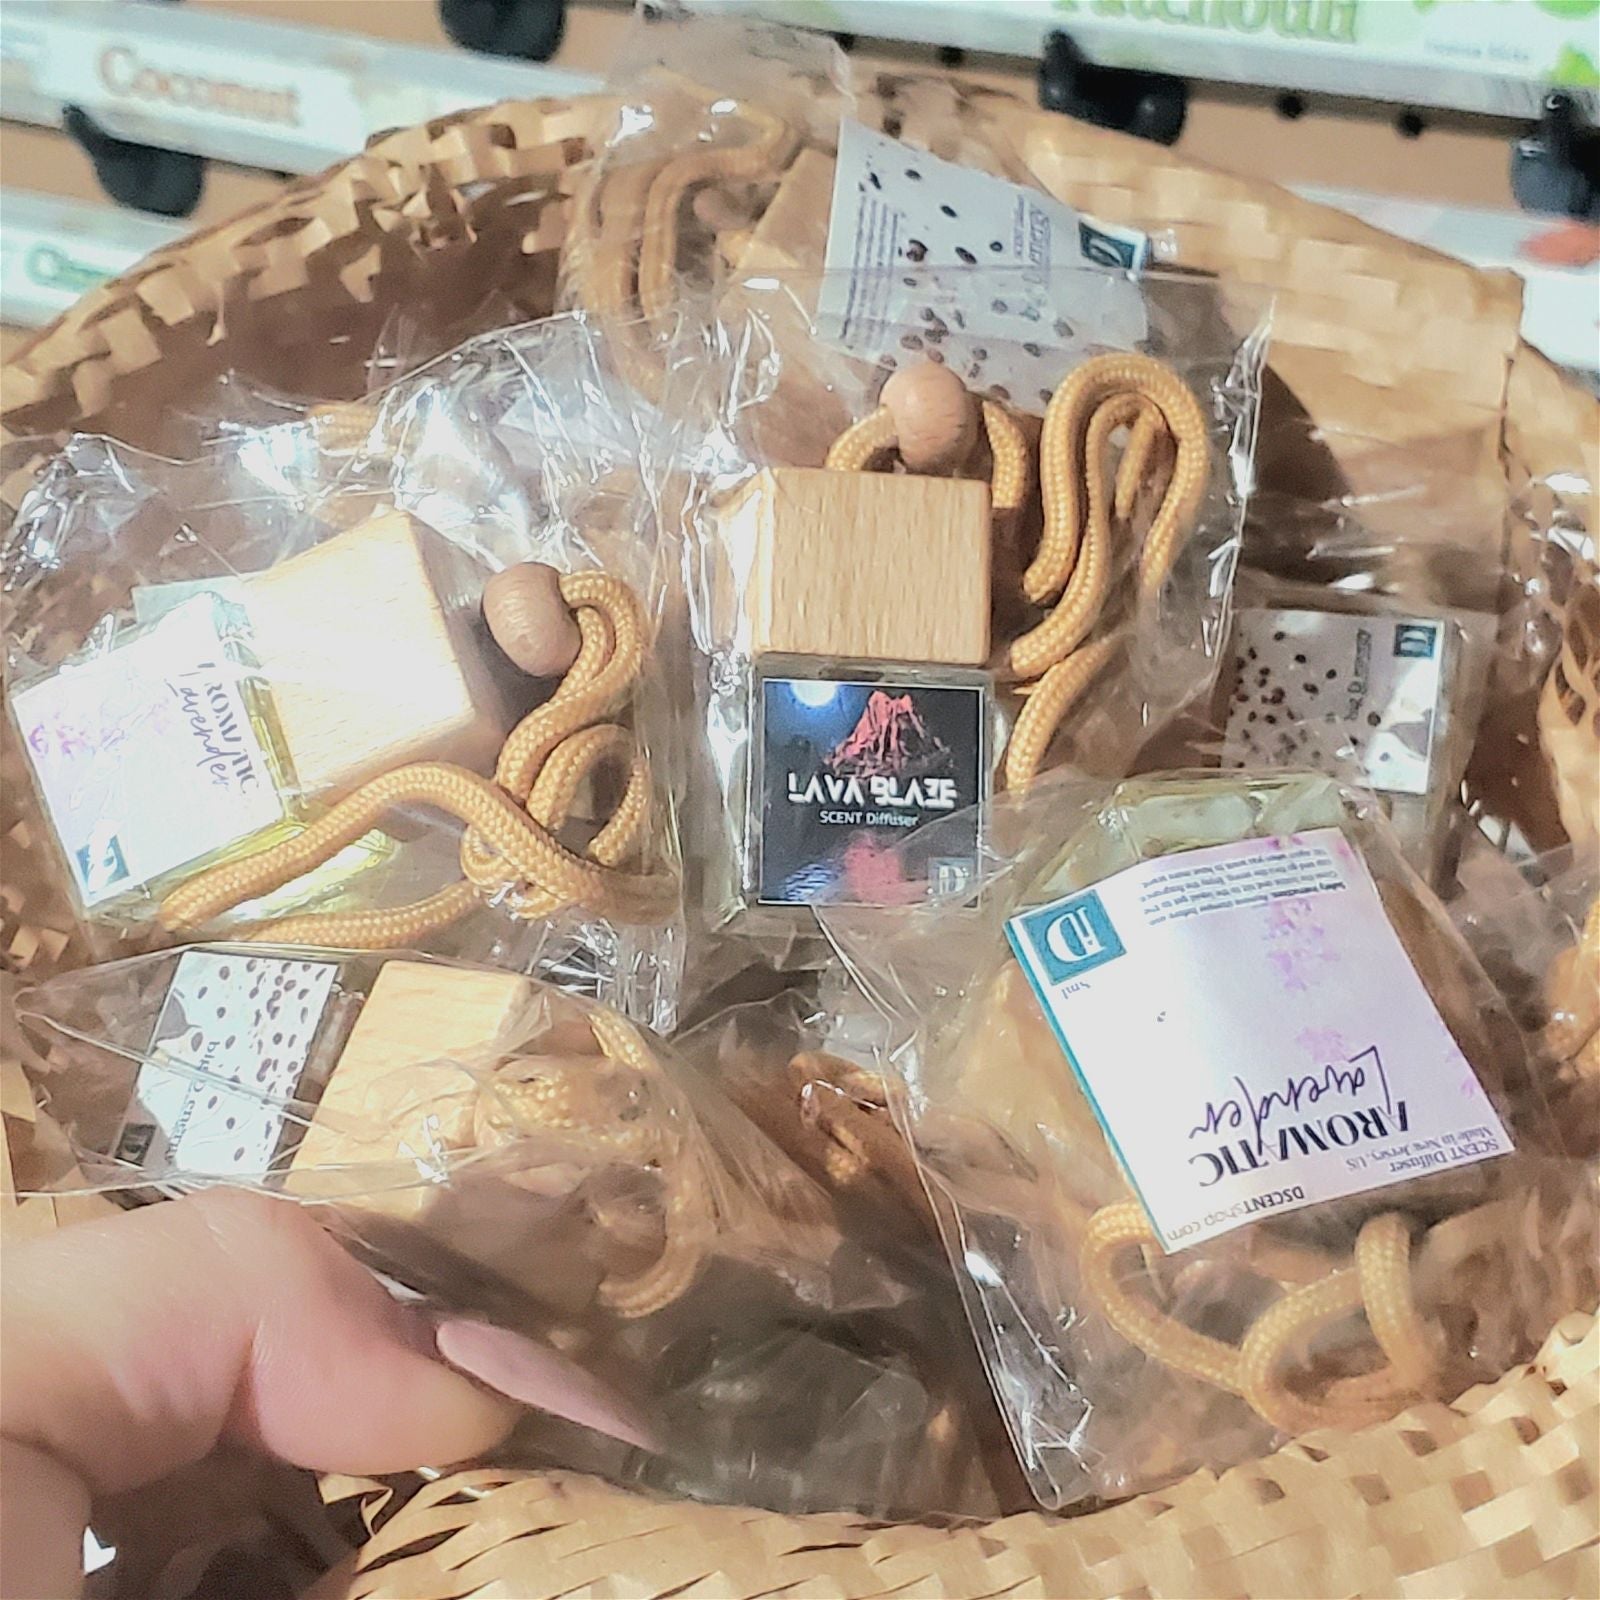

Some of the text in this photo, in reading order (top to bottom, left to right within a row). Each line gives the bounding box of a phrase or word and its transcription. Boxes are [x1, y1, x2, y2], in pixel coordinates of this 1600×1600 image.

[787, 771, 958, 810] LAVA BLAZE
[819, 810, 919, 827] SCENT Diffuser
[1188, 1045, 1392, 1157] Lavender
[1188, 1099, 1409, 1188] AROMATIC
[1389, 1137, 1500, 1173] SCENT Diffuser
